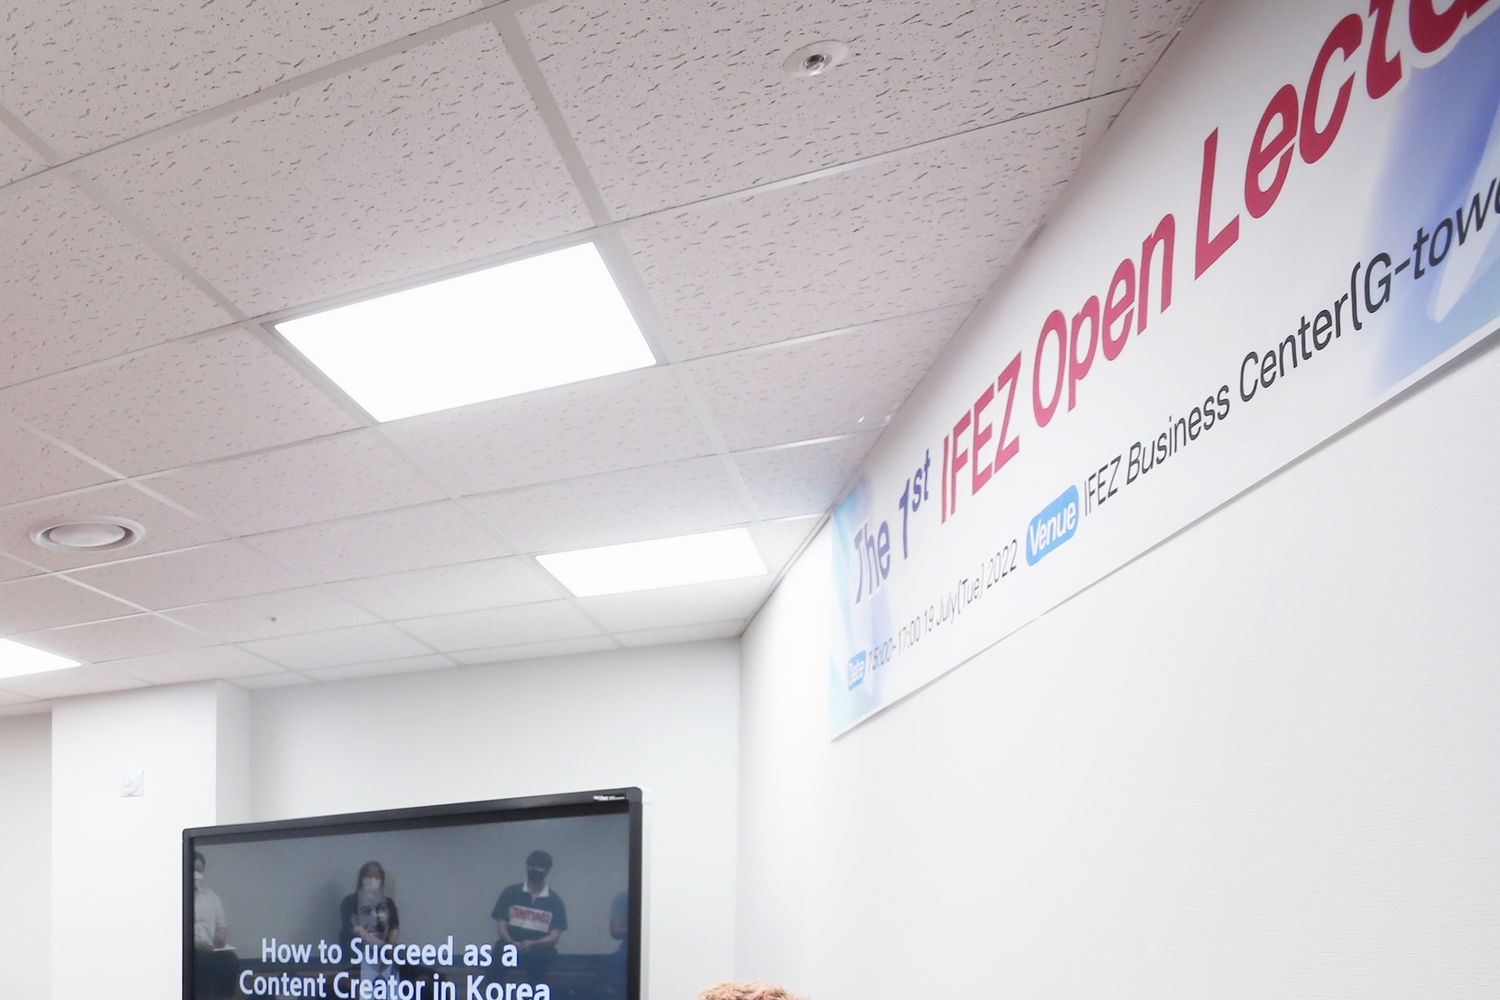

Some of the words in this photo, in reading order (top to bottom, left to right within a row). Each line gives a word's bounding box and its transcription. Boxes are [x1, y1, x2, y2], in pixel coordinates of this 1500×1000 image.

[849, 657, 865, 685] Date
[924, 605, 935, 636] 19
[936, 563, 985, 626] July(Tue)
[987, 538, 1018, 590] 2022
[1029, 500, 1077, 557] Venue
[1084, 455, 1122, 516] IFEZ
[1126, 385, 1230, 486] Business
[1239, 176, 1500, 402] Center(G-tow
[853, 520, 891, 604] The
[899, 448, 930, 560] 1st
[940, 352, 1022, 526] IFEZ
[1032, 213, 1176, 428] Open
[239, 970, 327, 998] Content
[261, 938, 311, 963] How
[318, 940, 342, 964] to
[350, 936, 453, 966] Succeed
[463, 944, 493, 967] as
[501, 944, 518, 967] a
